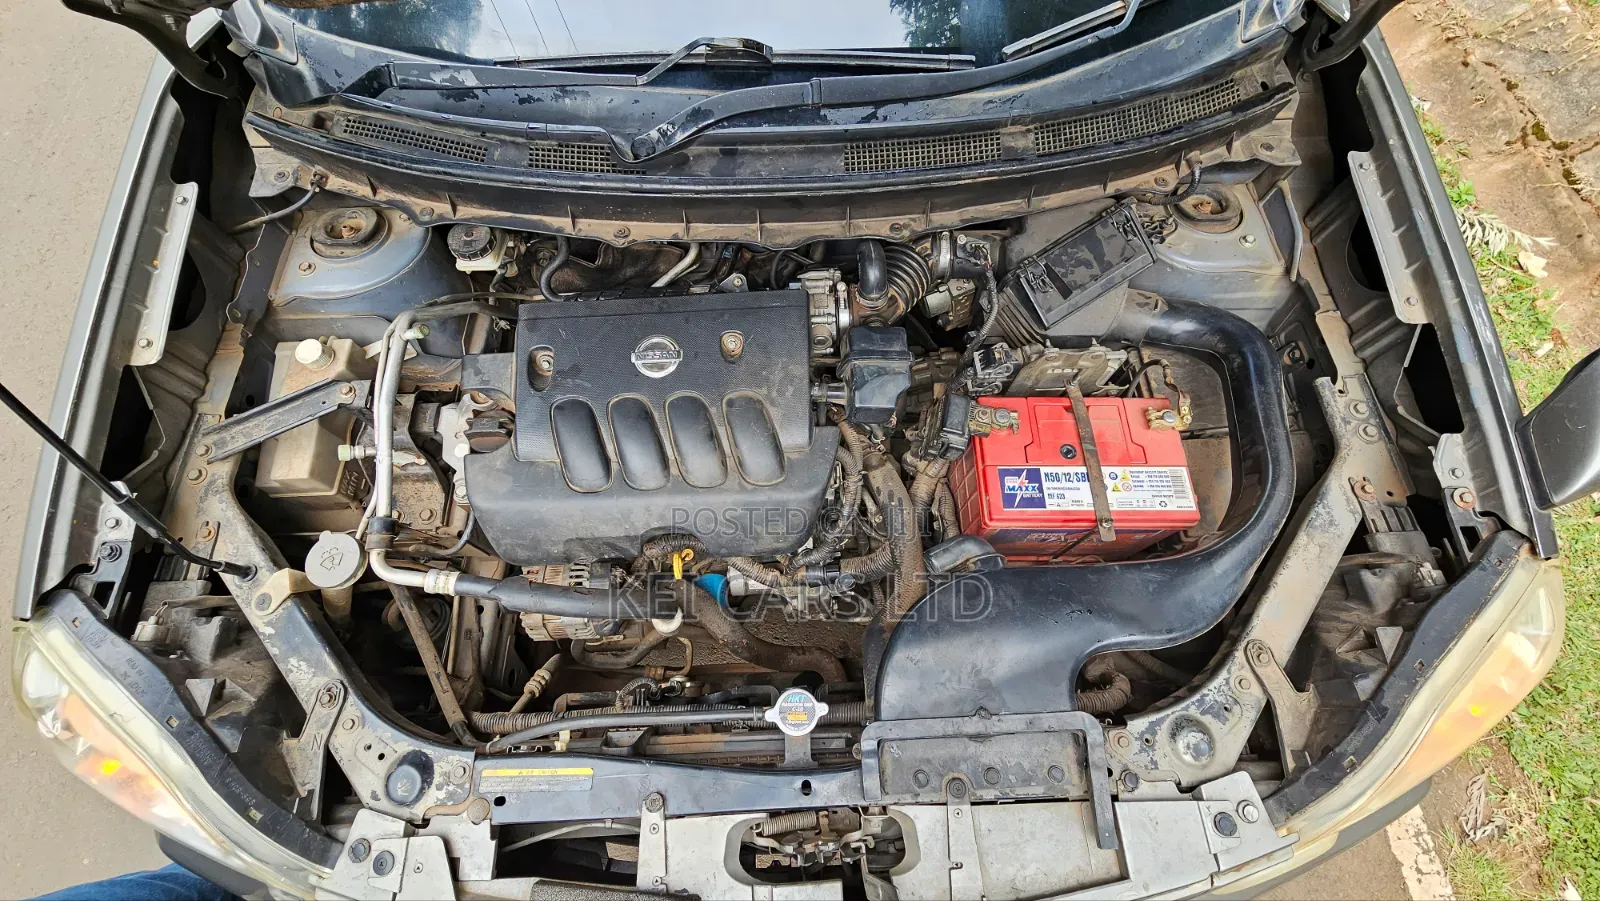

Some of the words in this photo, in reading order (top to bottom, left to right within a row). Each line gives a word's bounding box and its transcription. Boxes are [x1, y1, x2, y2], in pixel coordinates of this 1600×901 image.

[636, 351, 678, 360] NISSAN
[1005, 484, 1038, 492] MAXX
[787, 694, 807, 703] HKT
